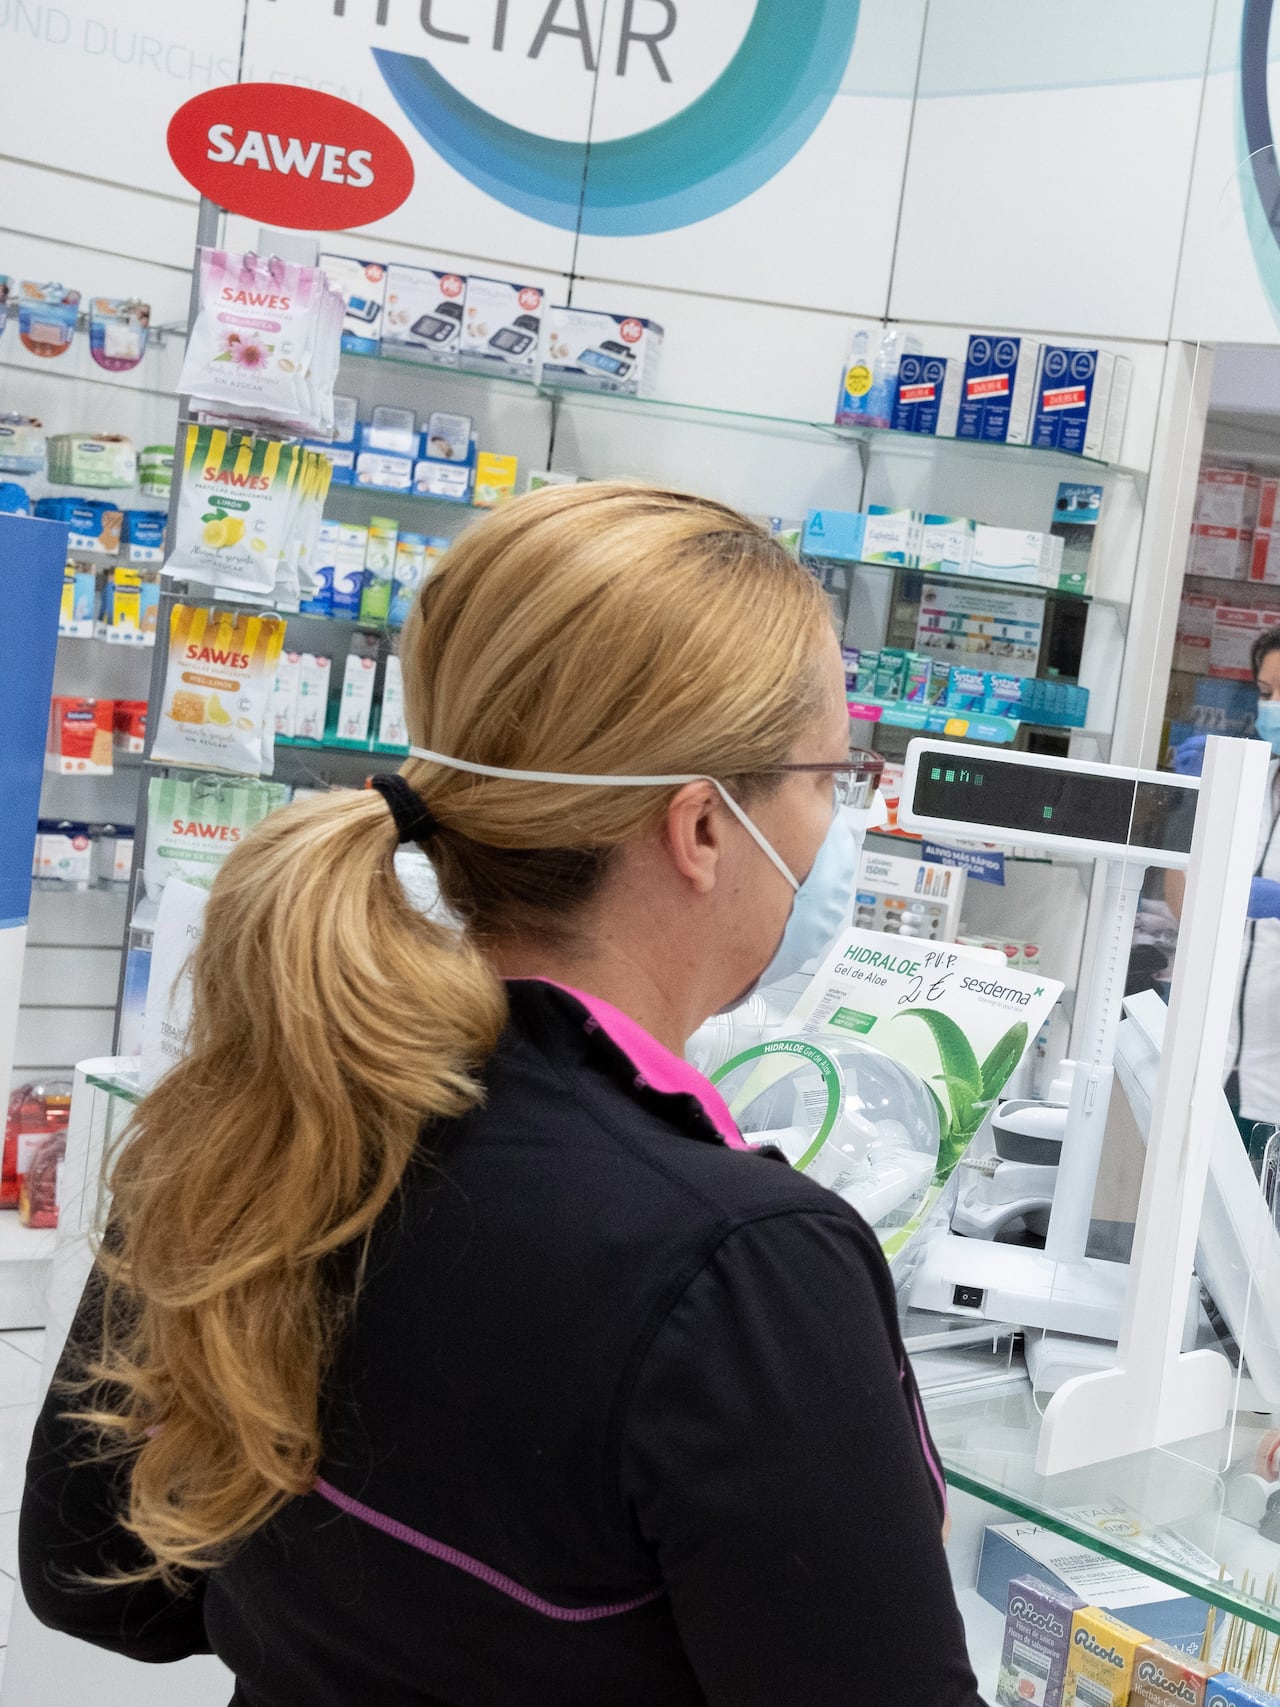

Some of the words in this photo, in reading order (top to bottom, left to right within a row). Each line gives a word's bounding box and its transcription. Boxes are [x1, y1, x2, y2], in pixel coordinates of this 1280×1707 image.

[207, 124, 375, 188] SAWES
[221, 286, 291, 312] SAWES
[203, 466, 270, 491] SAWES
[186, 644, 251, 670] SAWES
[172, 818, 241, 843] SAWES
[925, 845, 951, 859] ALIVIO
[952, 849, 971, 862] MÁS
[970, 854, 1001, 871] RÁPIDO
[834, 962, 849, 976] Gel
[849, 967, 865, 981] de
[865, 971, 888, 987] Aloe
[843, 944, 921, 978] HIDRALOE
[898, 975, 923, 1005] 2
[926, 972, 954, 1002] €
[959, 975, 1033, 1007] sesderma
[764, 1042, 805, 1053] HIDRALOE
[803, 1046, 814, 1059] Gel
[812, 1053, 823, 1063] de
[820, 1058, 832, 1075] Aloe
[1010, 1595, 1064, 1638] Ricola
[1075, 1627, 1124, 1670] Ricola
[1137, 1660, 1196, 1705] Ricola
